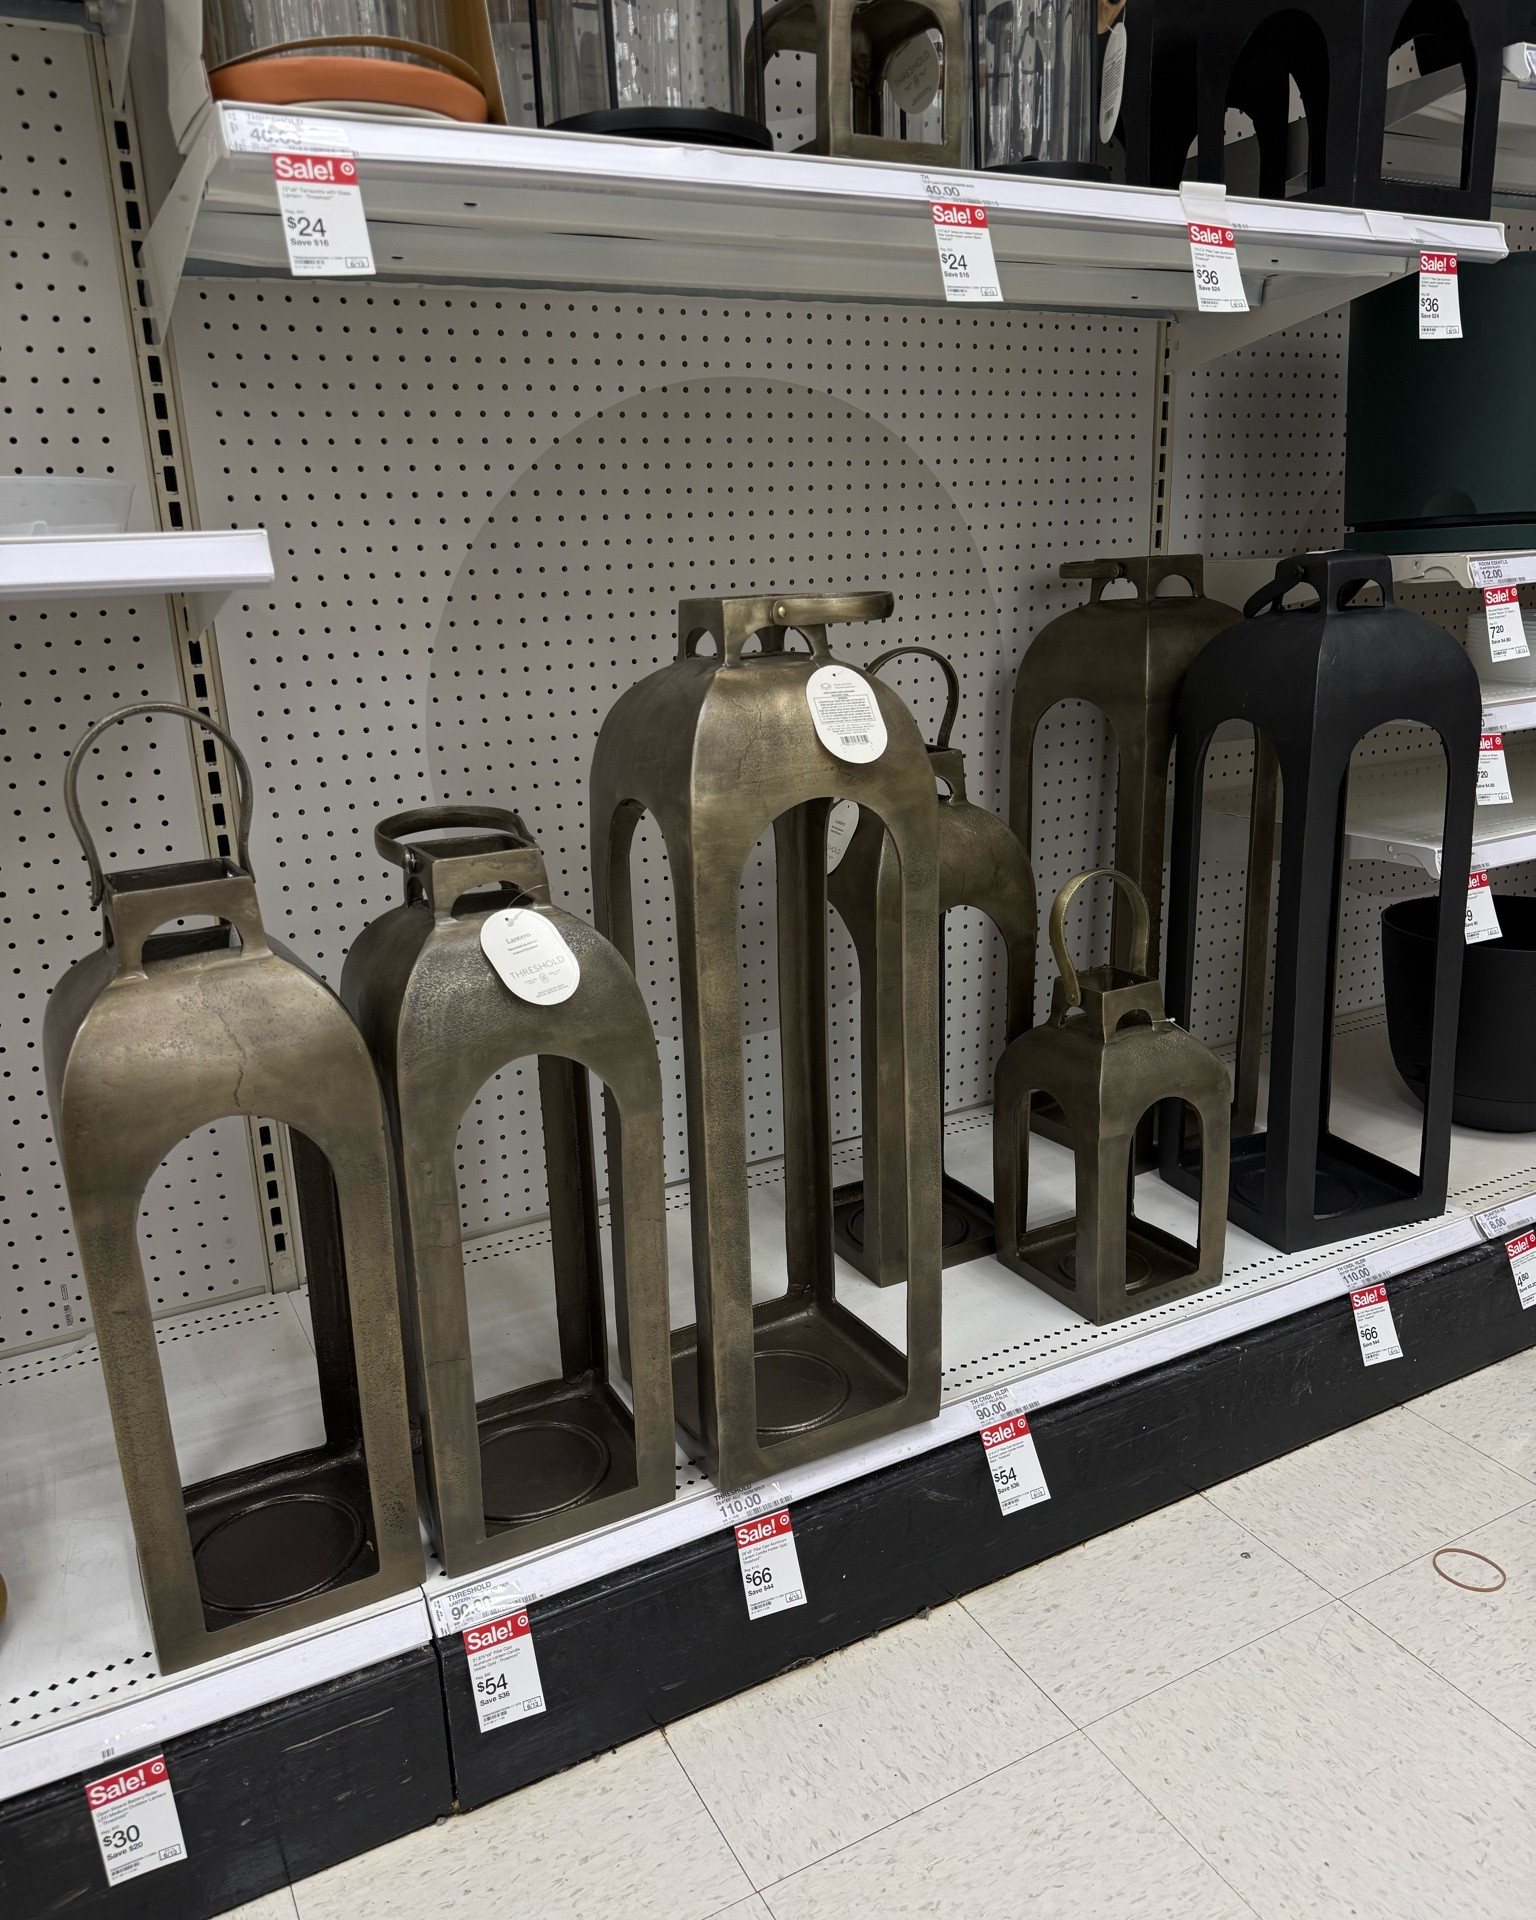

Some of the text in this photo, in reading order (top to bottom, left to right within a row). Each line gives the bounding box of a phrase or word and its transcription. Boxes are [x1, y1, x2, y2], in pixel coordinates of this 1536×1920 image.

[894, 50, 930, 88] THRESHOLD
[276, 157, 335, 181] Sale!
[926, 185, 961, 198] 40.00
[933, 205, 972, 225] Sale!
[287, 216, 327, 238] $24
[1191, 226, 1223, 245] Sale!
[291, 238, 330, 248] Save $16
[941, 253, 968, 271] $24
[1421, 255, 1447, 272] Sale!
[944, 270, 970, 279] Save $16
[1196, 268, 1219, 285] $36
[1198, 284, 1211, 292] Save
[1421, 297, 1439, 313] $36
[1481, 569, 1503, 580] 12.00
[1485, 589, 1510, 605] Sale!
[1479, 737, 1494, 750] ale!
[1468, 875, 1480, 888] le!
[505, 932, 532, 945] Lantern
[510, 955, 565, 980] THRESHOLD
[1489, 1217, 1507, 1230] 8.00
[1508, 1239, 1529, 1257] Sale!
[1342, 1268, 1371, 1285] 110.00
[1353, 1290, 1379, 1308] Sale!
[1360, 1326, 1378, 1341] $66
[970, 1387, 1010, 1406] TH CNDL HLDR
[976, 1401, 1007, 1421] 90.00
[982, 1422, 1016, 1447] Sale!
[994, 1467, 1018, 1486] $54
[997, 1485, 1011, 1495] Save
[720, 1493, 762, 1519] 110.00
[738, 1519, 777, 1546] Sale!
[745, 1567, 773, 1587] $66
[447, 1581, 492, 1602] THRESHOLD
[748, 1588, 763, 1597] Save
[448, 1595, 471, 1608] LANTERN
[467, 1620, 514, 1651] Sale!
[477, 1673, 508, 1695] $54
[480, 1690, 511, 1707] Save $36
[90, 1769, 147, 1806] Sale!
[103, 1824, 141, 1849] $30
[107, 1841, 144, 1861] Save $20
